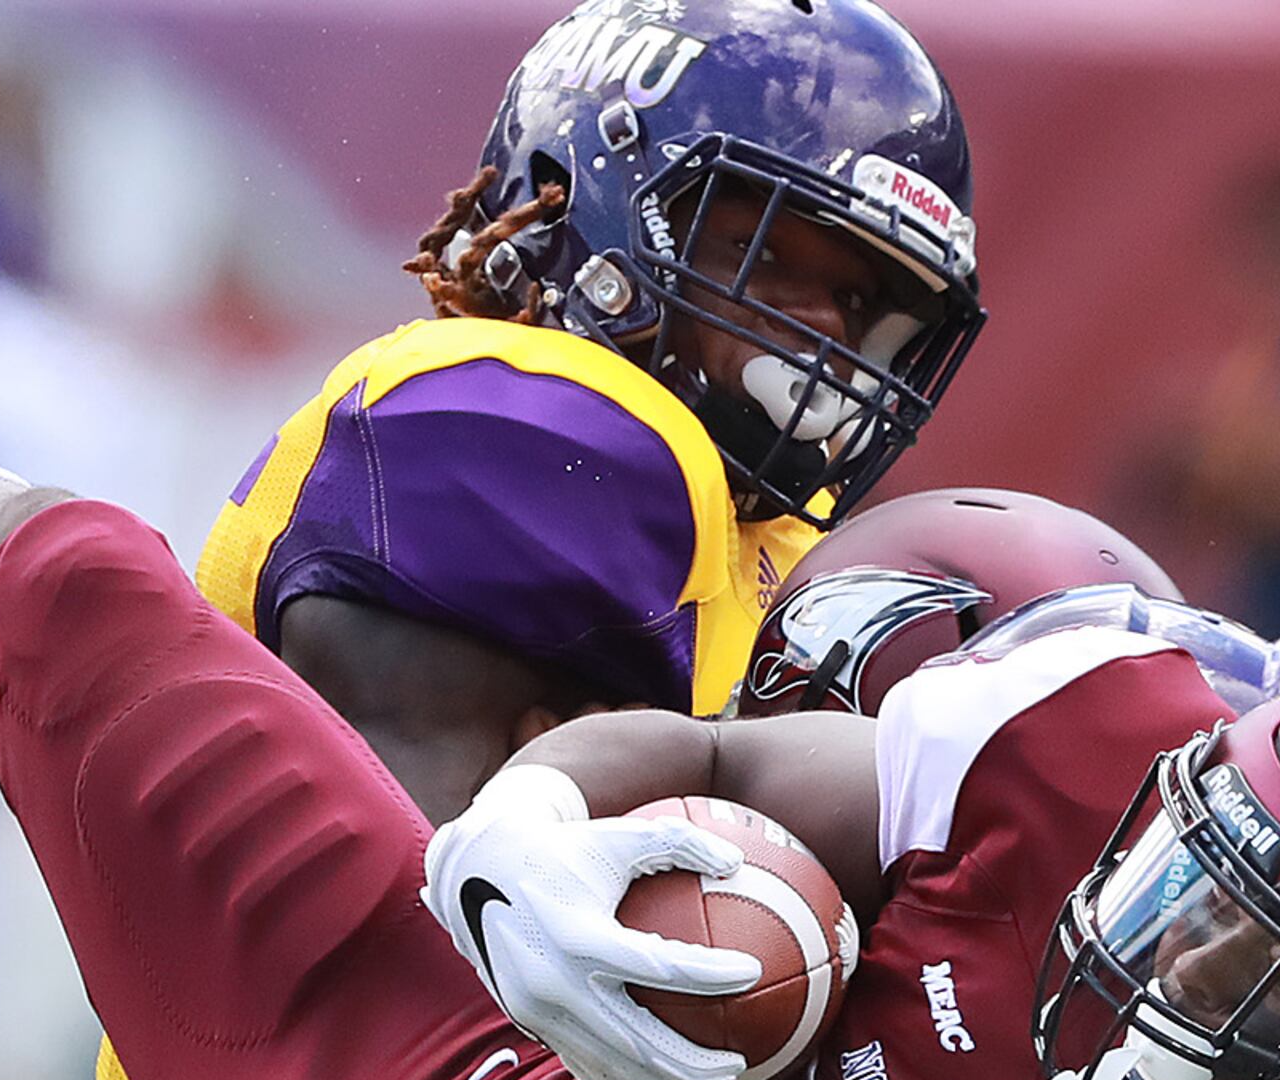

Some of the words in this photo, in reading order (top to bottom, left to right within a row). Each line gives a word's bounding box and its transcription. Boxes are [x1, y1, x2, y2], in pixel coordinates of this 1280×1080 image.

[891, 170, 952, 229] Riddell
[1207, 765, 1280, 856] Riddell
[919, 960, 976, 1053] MEAC
